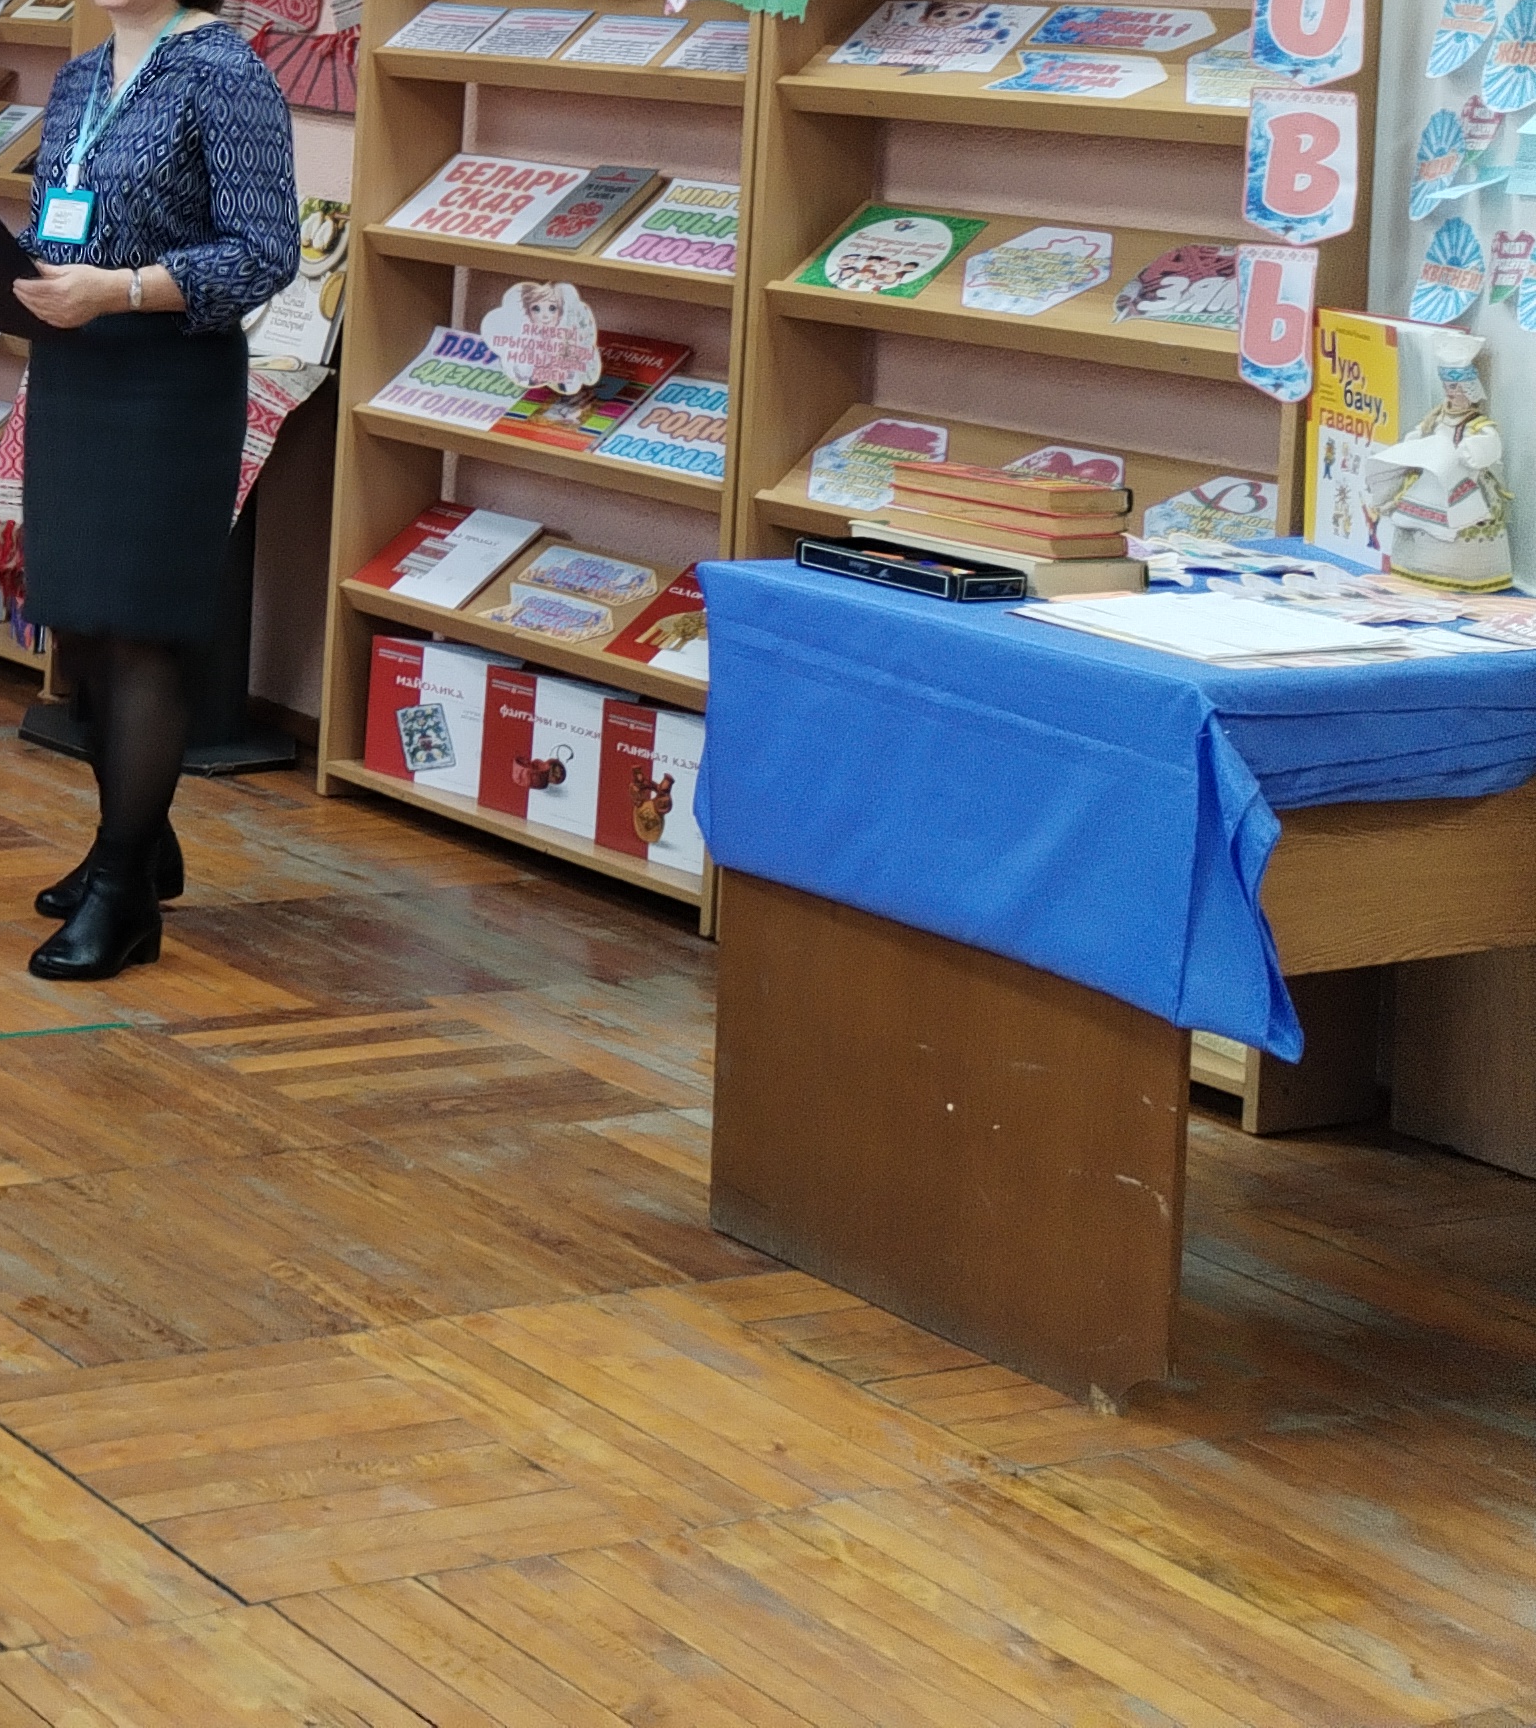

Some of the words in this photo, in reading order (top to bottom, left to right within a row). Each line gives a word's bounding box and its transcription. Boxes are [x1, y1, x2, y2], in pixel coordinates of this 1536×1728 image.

[444, 161, 582, 195] БЕЛАРУ
[438, 186, 535, 217] СКАЯ
[663, 185, 739, 211] МІЛАГ
[411, 208, 514, 240] МОВА
[642, 209, 739, 240] ШЧЫР
[493, 335, 565, 353] ПРЫГОЖЫЯ
[507, 351, 547, 367] МОВЫ
[1320, 328, 1366, 389] Чую,
[654, 383, 728, 414] ПРЫГ
[1343, 380, 1388, 427] бачу,
[637, 407, 728, 445] РОДН
[1319, 408, 1375, 448] гавару
